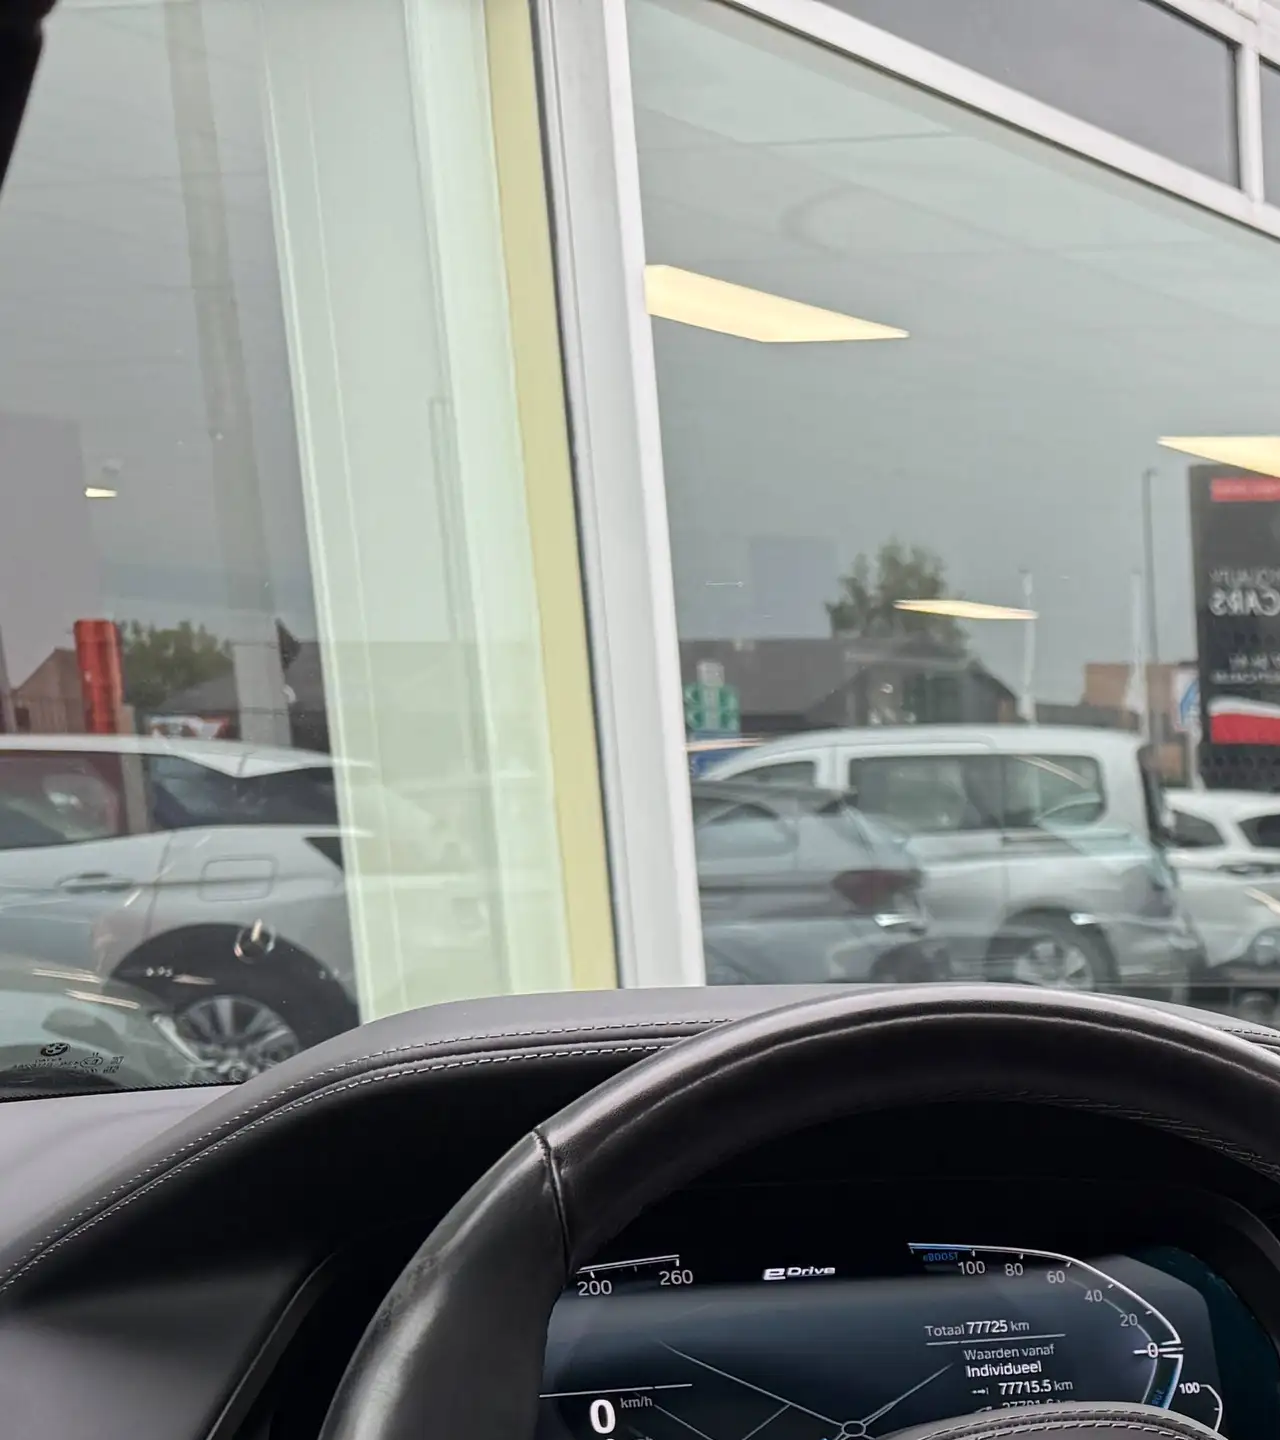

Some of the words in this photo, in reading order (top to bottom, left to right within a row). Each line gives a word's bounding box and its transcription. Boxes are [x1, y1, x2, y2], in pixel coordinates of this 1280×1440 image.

[958, 1261, 985, 1275] 100
[1005, 1263, 1024, 1276] 80
[659, 1269, 693, 1285] 260
[1046, 1270, 1066, 1284] 60
[577, 1280, 612, 1296] 200
[1084, 1289, 1103, 1303] 40
[1120, 1313, 1138, 1327] 20
[924, 1325, 965, 1337] Totaal
[966, 1320, 1008, 1335] 77725
[1010, 1320, 1030, 1332] km
[964, 1347, 1019, 1361] Waarden
[1021, 1343, 1055, 1357] vanaf
[1147, 1342, 1159, 1358] 0
[965, 1360, 1042, 1378] Individueel
[999, 1379, 1052, 1396] 77715.5
[1054, 1380, 1073, 1391] km
[1179, 1382, 1200, 1394] 100
[589, 1399, 616, 1434] 0
[620, 1396, 653, 1409] km/h
